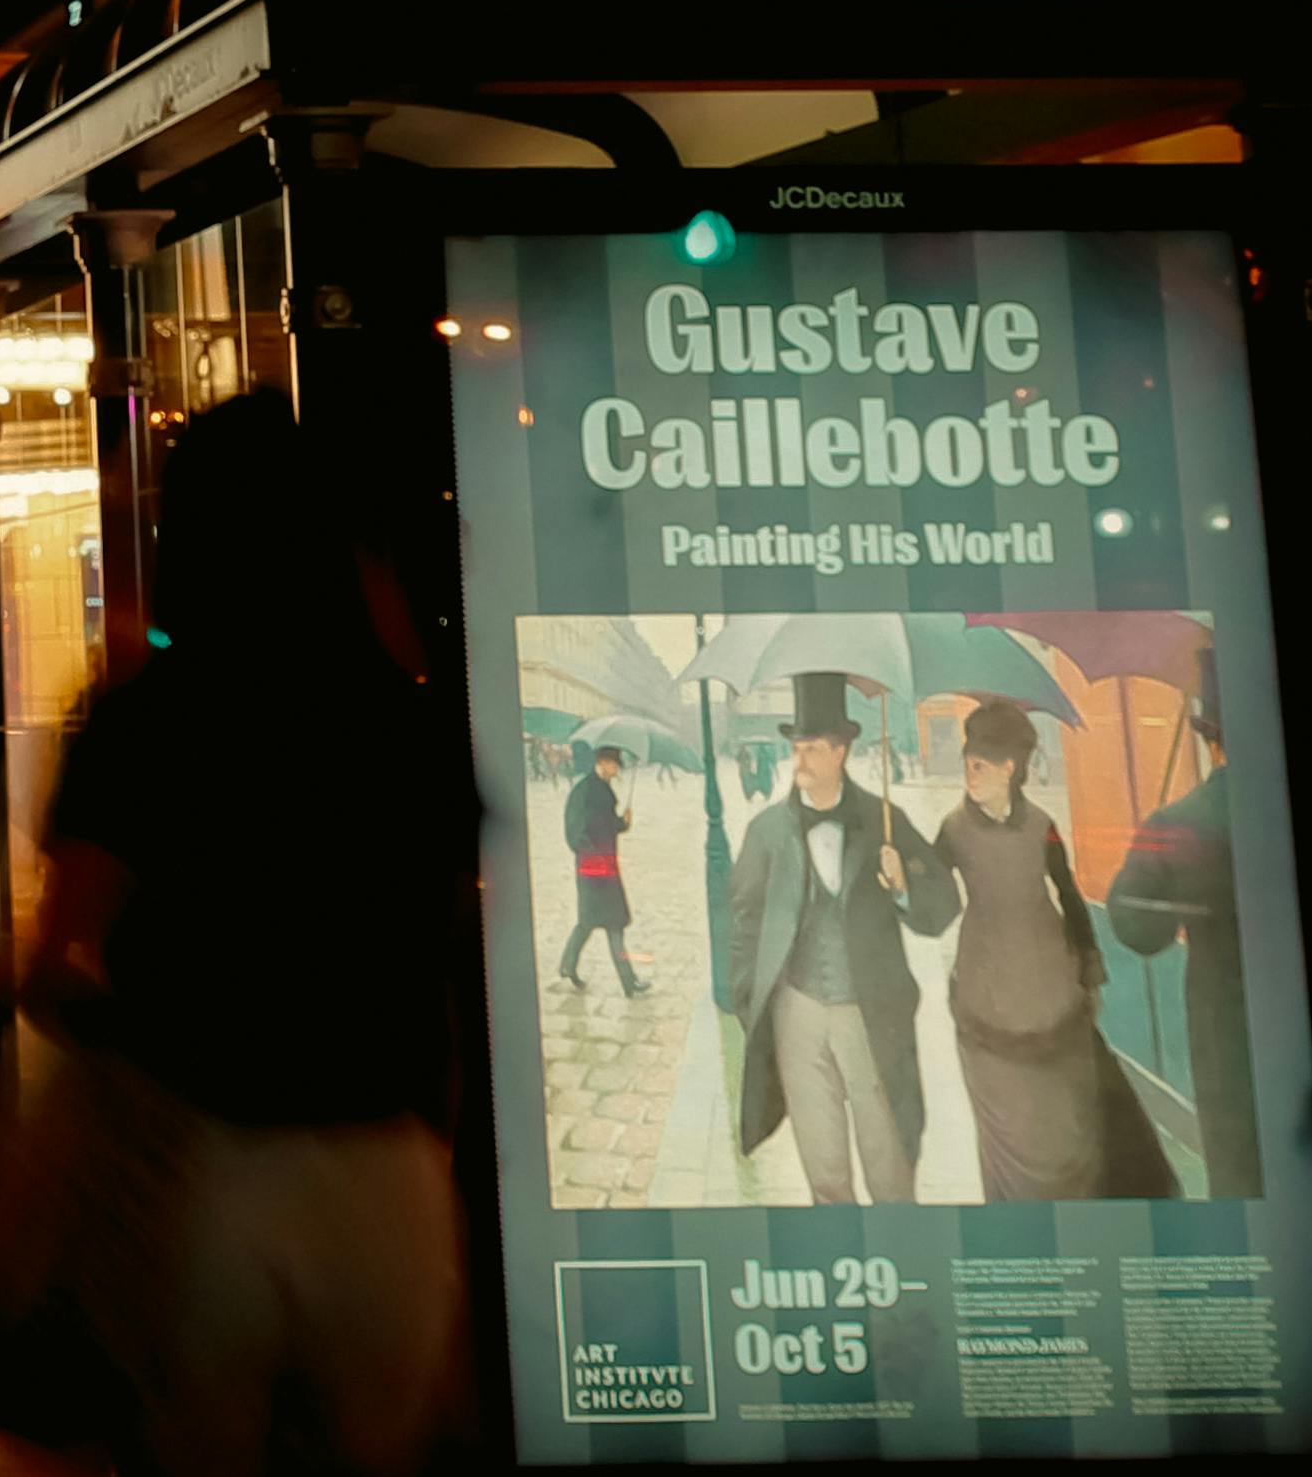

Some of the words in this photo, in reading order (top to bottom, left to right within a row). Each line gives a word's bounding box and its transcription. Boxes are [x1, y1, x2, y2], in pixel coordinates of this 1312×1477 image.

[769, 186, 906, 210] JCDecaux
[643, 281, 1042, 375] Gustave
[579, 396, 1121, 490] Caillebotte
[662, 524, 843, 575] Painting
[849, 523, 920, 566] His
[924, 522, 1055, 565] World
[730, 1258, 826, 1310] Jun
[573, 1343, 618, 1364] ART
[734, 1322, 827, 1375] Oct
[831, 1320, 868, 1376] 5
[575, 1388, 684, 1410] CHICAGO
